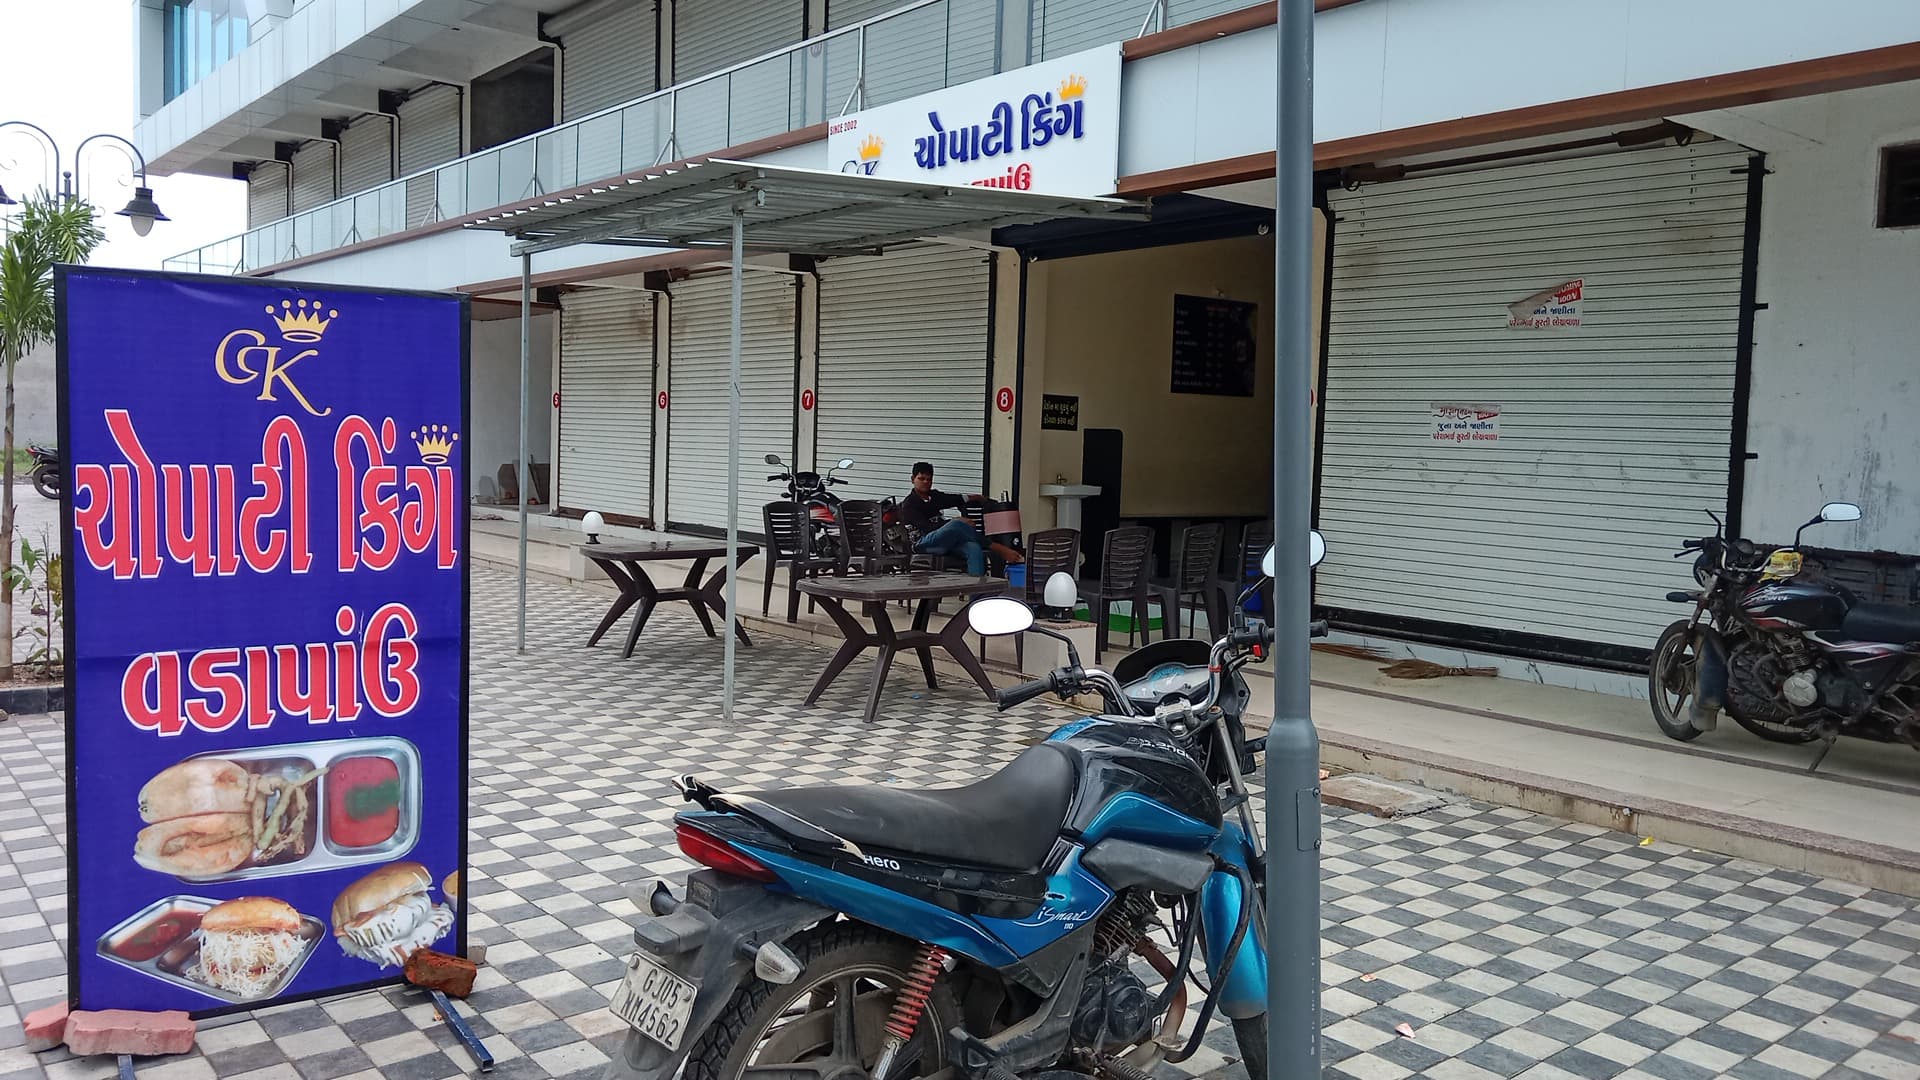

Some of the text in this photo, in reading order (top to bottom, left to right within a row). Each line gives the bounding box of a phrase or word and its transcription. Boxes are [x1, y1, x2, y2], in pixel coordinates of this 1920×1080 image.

[830, 119, 857, 135] SINCE 2002
[914, 92, 1083, 169] ચોપાટી કિંગ
[1000, 391, 1008, 407] 8
[74, 409, 458, 580] ચોપાટી કિંગ
[121, 603, 420, 737] વડાપાંઉ
[864, 855, 900, 870] Hero
[1037, 906, 1087, 921] iSmart
[643, 968, 682, 1009] GJ05
